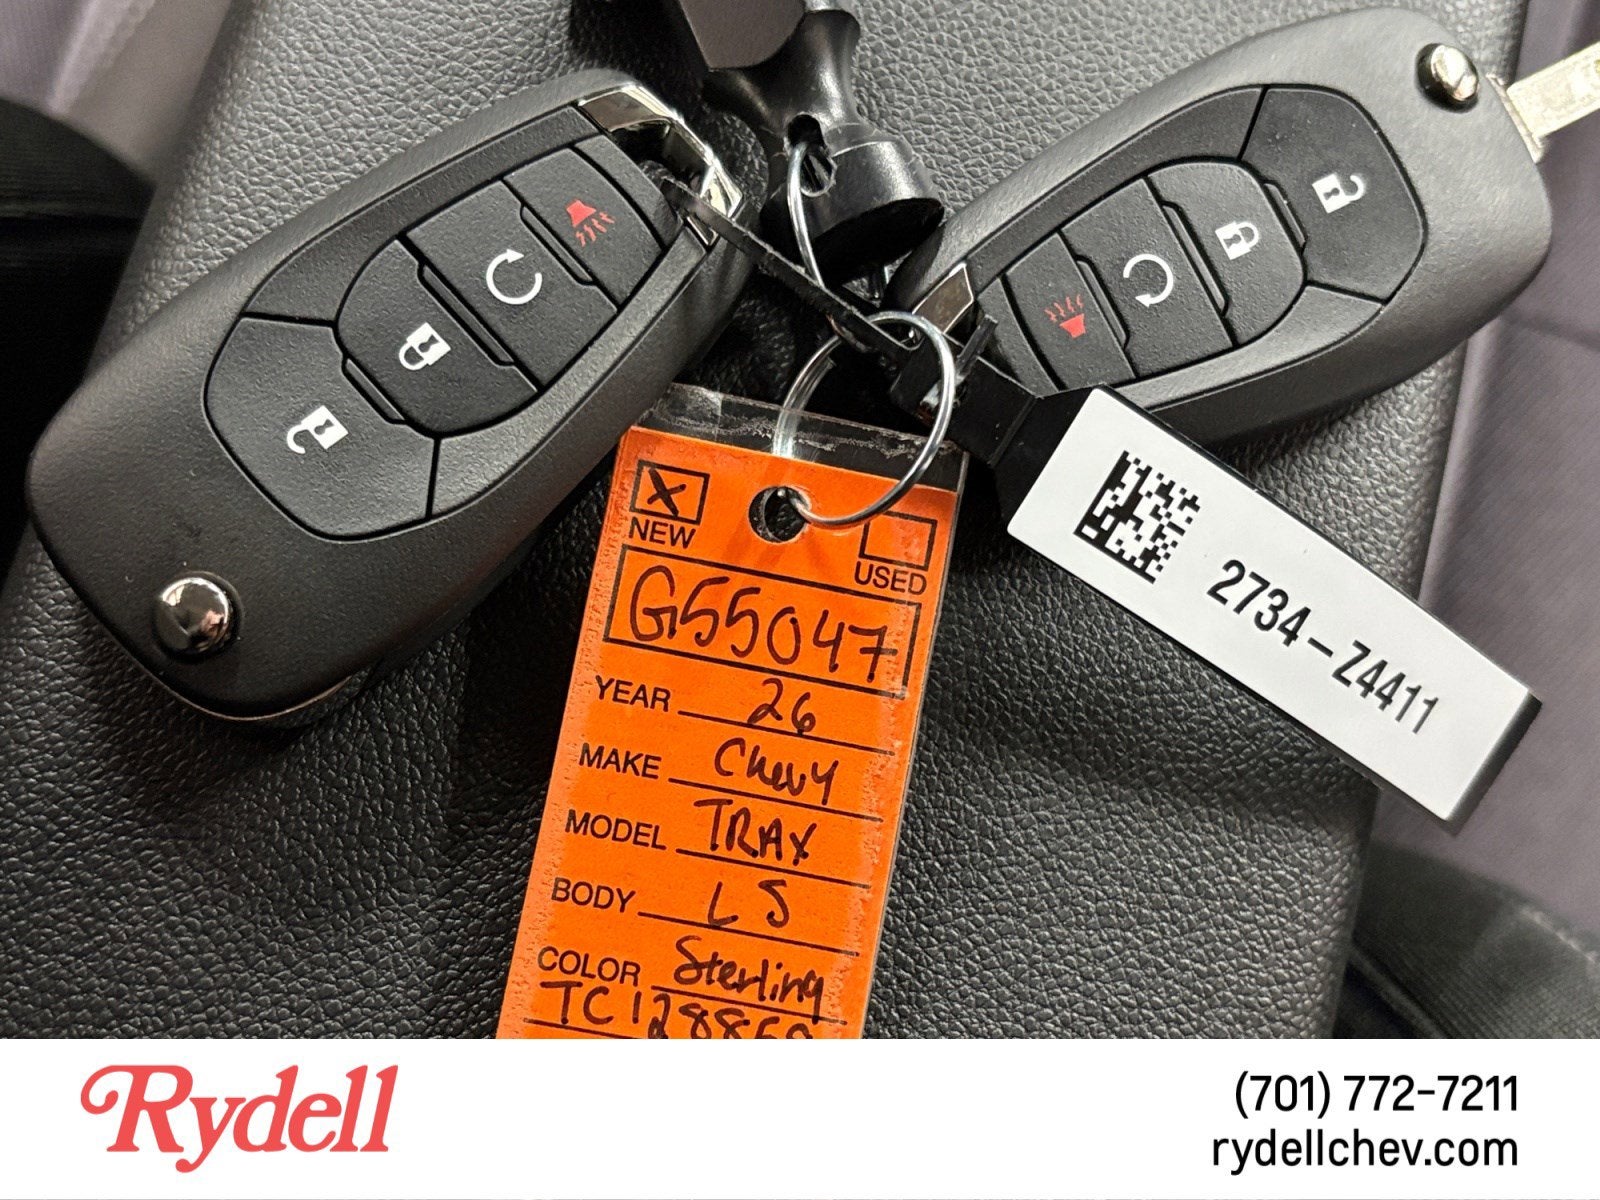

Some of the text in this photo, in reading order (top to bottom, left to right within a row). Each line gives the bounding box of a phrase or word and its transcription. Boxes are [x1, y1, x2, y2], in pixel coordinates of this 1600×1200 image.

[629, 517, 696, 549] NEW
[854, 561, 927, 595] USED
[629, 565, 898, 682] G55047
[1206, 559, 1440, 735] 2734-Z4411
[595, 676, 671, 712] YEAR
[748, 678, 816, 734] 26
[579, 743, 662, 780] MAKE
[565, 809, 666, 851] MODEL
[694, 798, 817, 866] TRAX
[551, 877, 636, 913] BODY
[538, 946, 641, 987] COLOR
[673, 935, 824, 1025] Sterling
